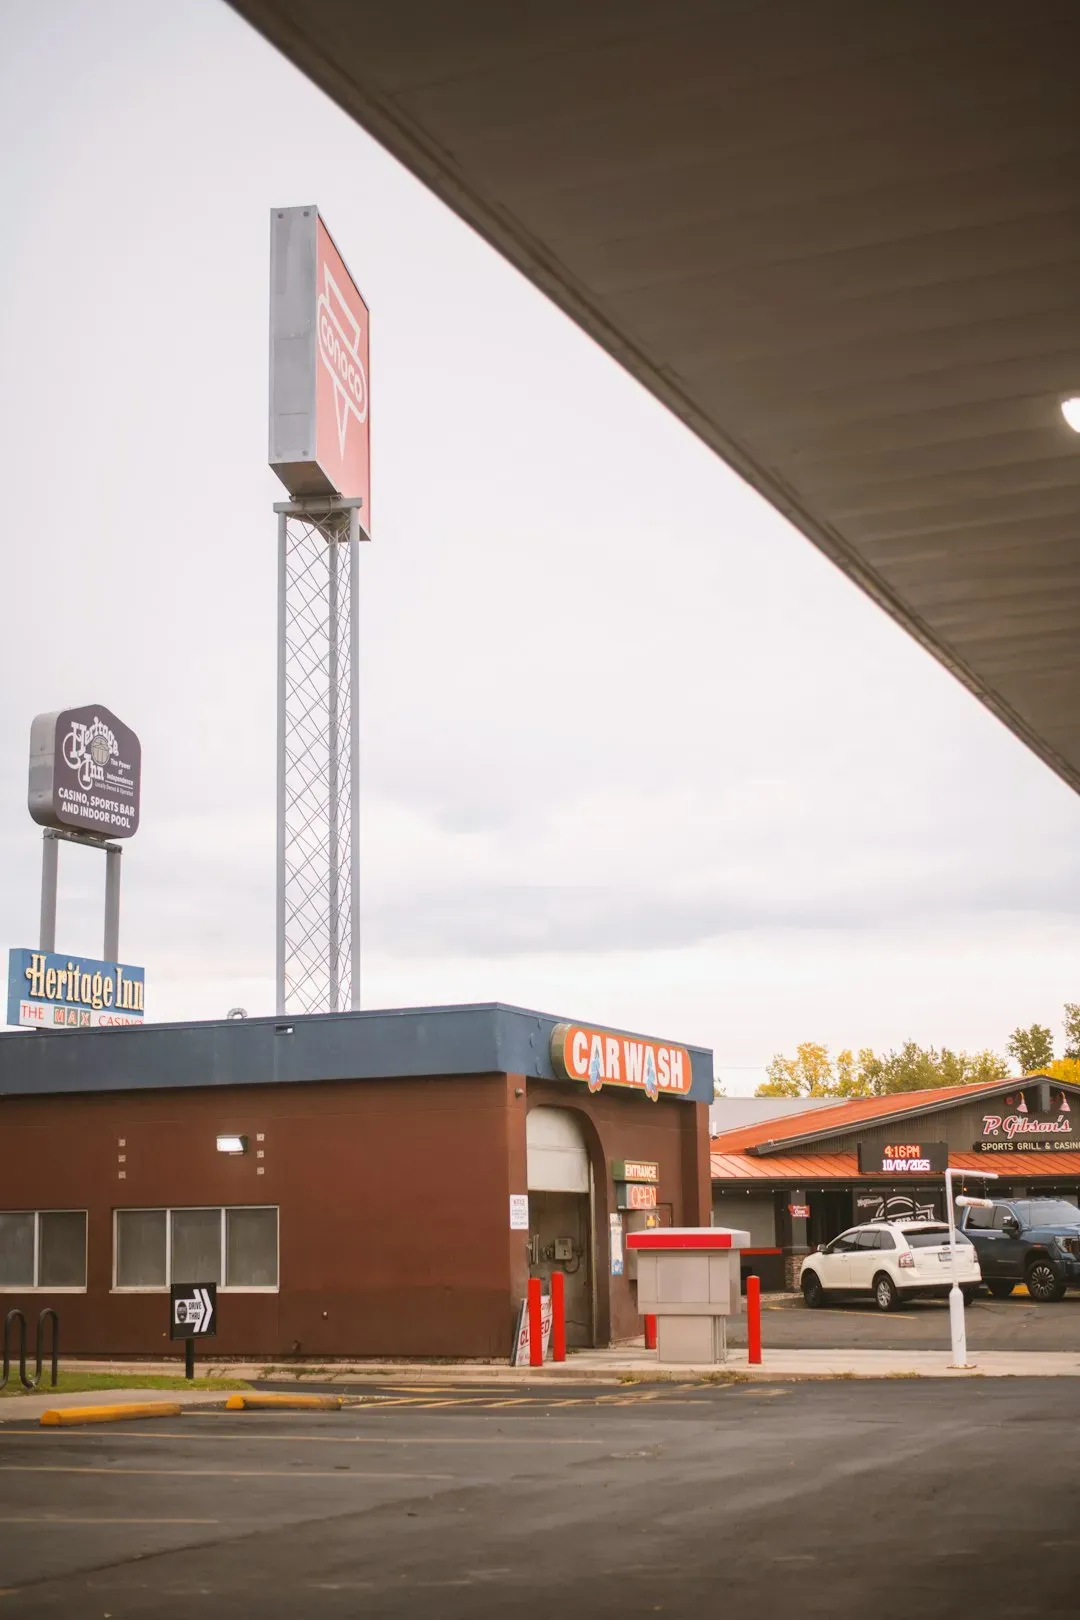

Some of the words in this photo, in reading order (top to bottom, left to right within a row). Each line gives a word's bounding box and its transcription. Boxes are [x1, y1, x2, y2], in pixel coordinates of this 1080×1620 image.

[62, 716, 119, 769] Heritage
[78, 753, 104, 791] Inn
[61, 801, 79, 815] AND
[80, 808, 110, 823] INDOOR
[111, 815, 131, 829] POOL
[90, 796, 119, 813] SPORTS
[120, 804, 135, 817] BAR
[25, 953, 113, 1010] Heritage
[115, 967, 144, 1011] Inn
[21, 1005, 44, 1020] THE
[54, 1007, 91, 1026] MAX
[572, 1031, 620, 1081] CAR
[624, 1041, 684, 1089] WASH
[983, 1115, 1001, 1136] P.
[1002, 1115, 1072, 1139] Gibson's
[981, 1142, 1014, 1151] SPORTS
[1017, 1142, 1041, 1150] GRILL
[1044, 1142, 1051, 1150] &
[1054, 1141, 1080, 1150] CASIN
[625, 1164, 657, 1179] ENTRANCE
[882, 1159, 931, 1171] 10/04/2025
[631, 1185, 657, 1208] OPEN
[189, 1302, 202, 1310] DRIVE
[189, 1312, 200, 1320] THRU
